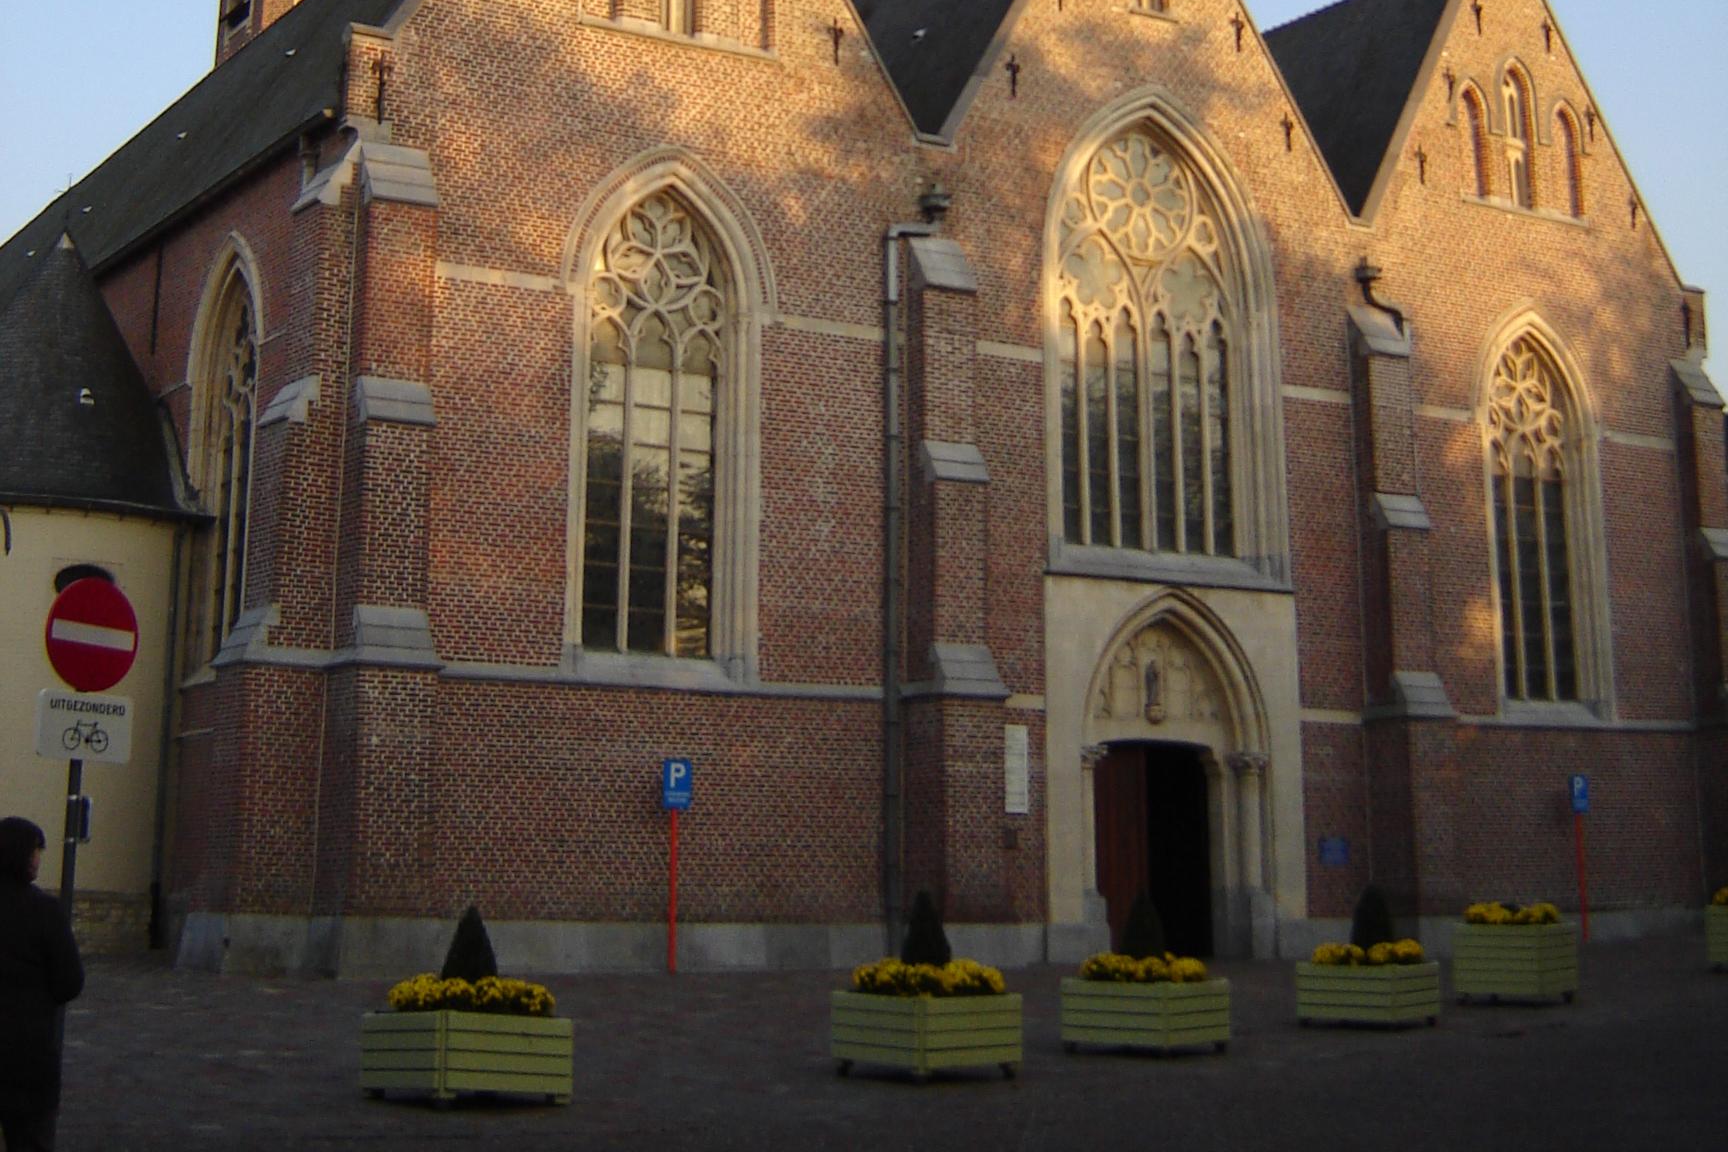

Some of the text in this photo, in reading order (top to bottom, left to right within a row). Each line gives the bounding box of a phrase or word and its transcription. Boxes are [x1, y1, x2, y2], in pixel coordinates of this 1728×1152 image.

[50, 698, 126, 716] UITGEZONDERD
[670, 762, 686, 788] P
[1573, 776, 1584, 797] P
